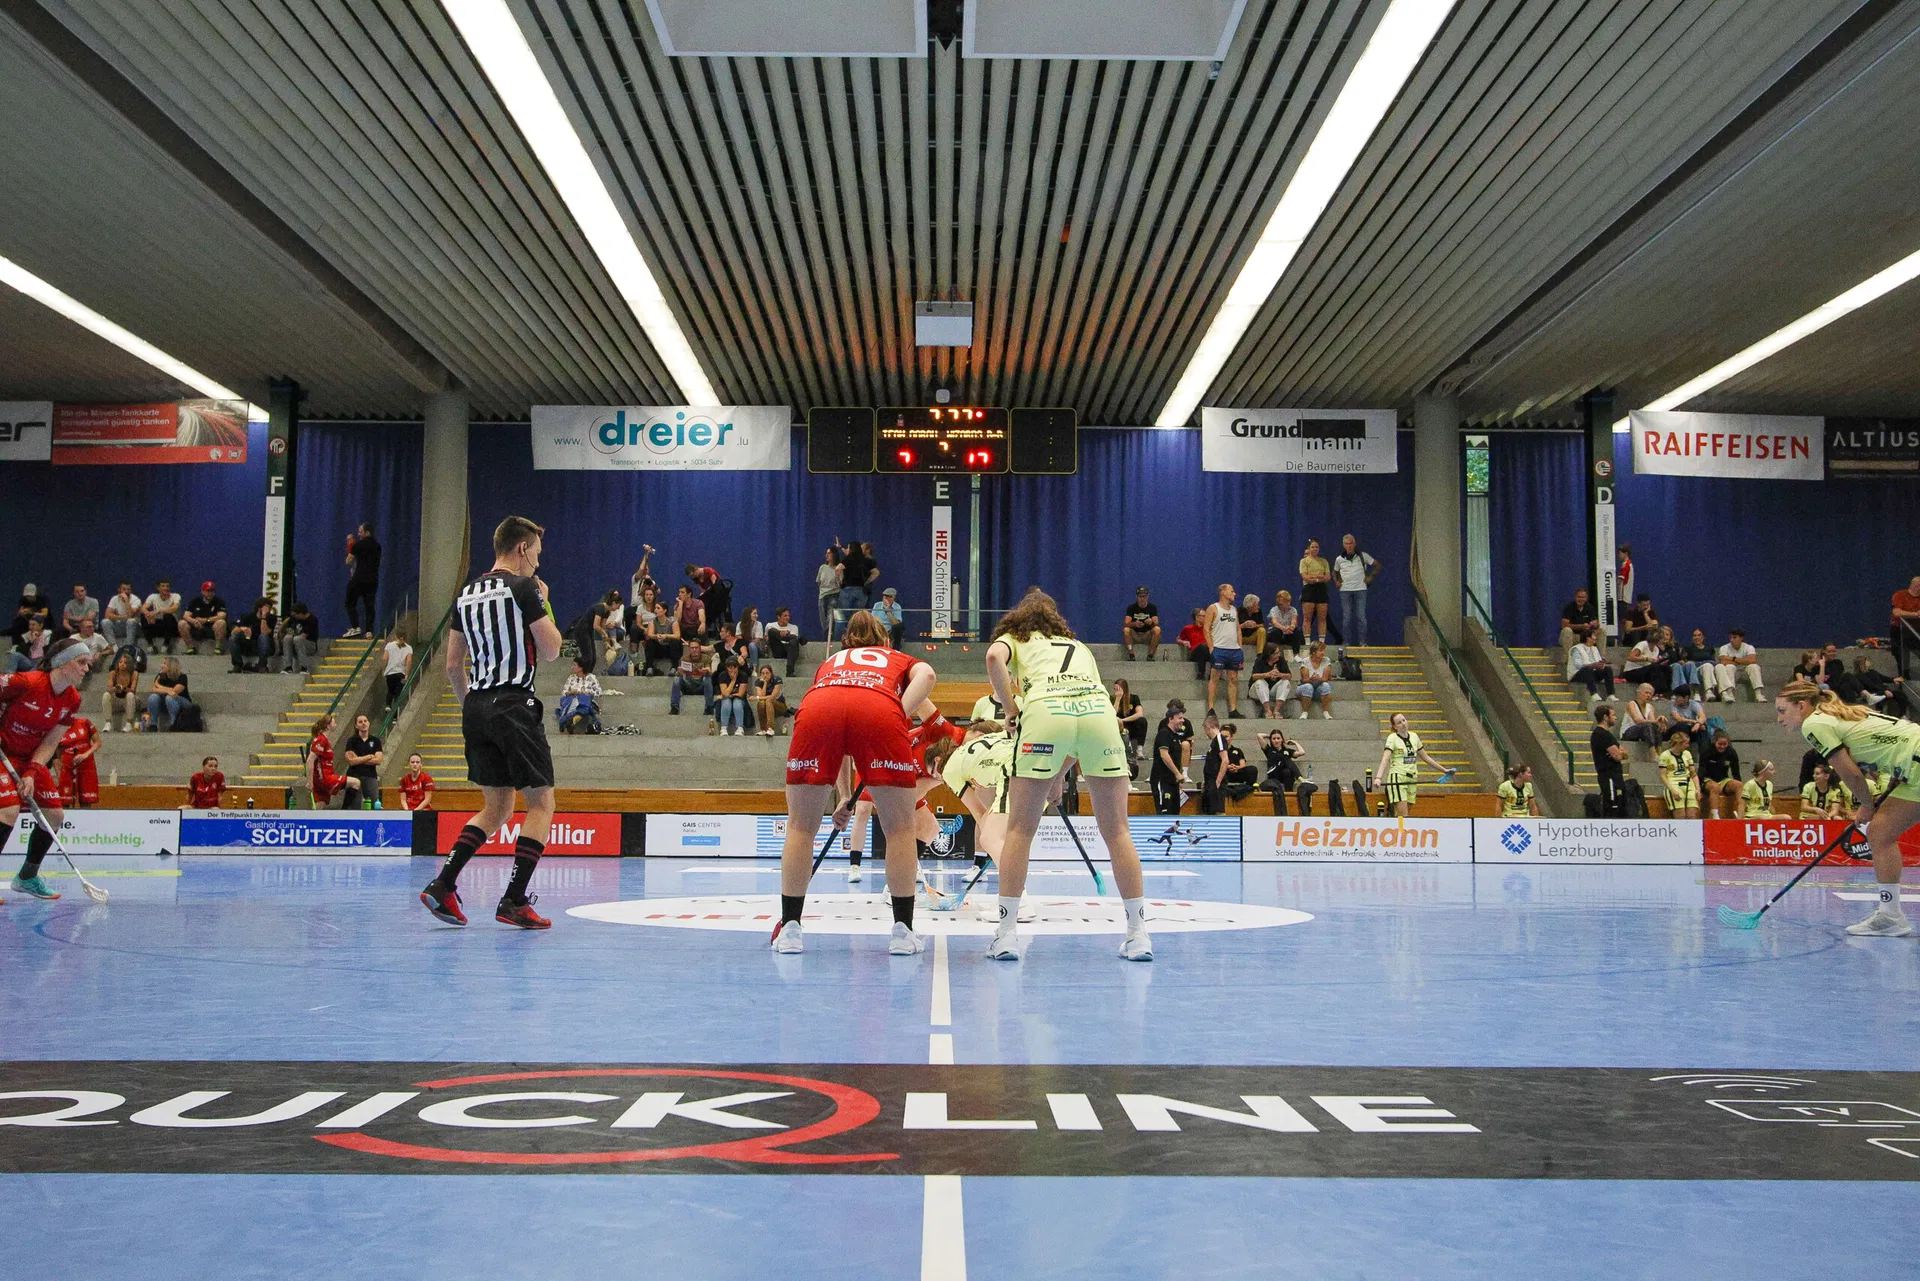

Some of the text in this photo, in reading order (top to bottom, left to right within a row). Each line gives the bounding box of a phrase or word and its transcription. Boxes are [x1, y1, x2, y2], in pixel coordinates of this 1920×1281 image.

[554, 410, 749, 446] www. dreier .lu
[1230, 418, 1301, 438] Grund
[1644, 430, 1809, 459] RAIFFEISEN
[1832, 431, 1919, 448] ALTIUS
[610, 458, 644, 466] Transporte
[655, 458, 680, 467] Logistik
[1286, 461, 1366, 472] Die Baumeister
[270, 476, 284, 495] F
[936, 481, 950, 499] E
[1597, 486, 1613, 504] D
[935, 611, 947, 632] AG
[826, 646, 889, 668] 16
[1051, 642, 1078, 674] 7
[44, 707, 54, 719] 2
[1062, 699, 1094, 714] GAST
[220, 811, 252, 819] Treffpunkt
[245, 820, 295, 829] Gasthof zum
[500, 822, 595, 845] Miliar
[1538, 822, 1678, 840] Hypothekarbank
[72, 833, 145, 847] nachhaltig.
[251, 824, 363, 845] SCHÜTZEN
[1275, 820, 1439, 848] Heizmann
[1745, 824, 1825, 845] Heizöl
[1275, 849, 1334, 857] Schlauchtechnik
[1383, 850, 1440, 858] Antriebstechnik
[1538, 843, 1613, 861] Lenzburg
[1752, 847, 1819, 858] midland.ch
[1851, 842, 1870, 853] Mid
[903, 1092, 1482, 1134] LINE
